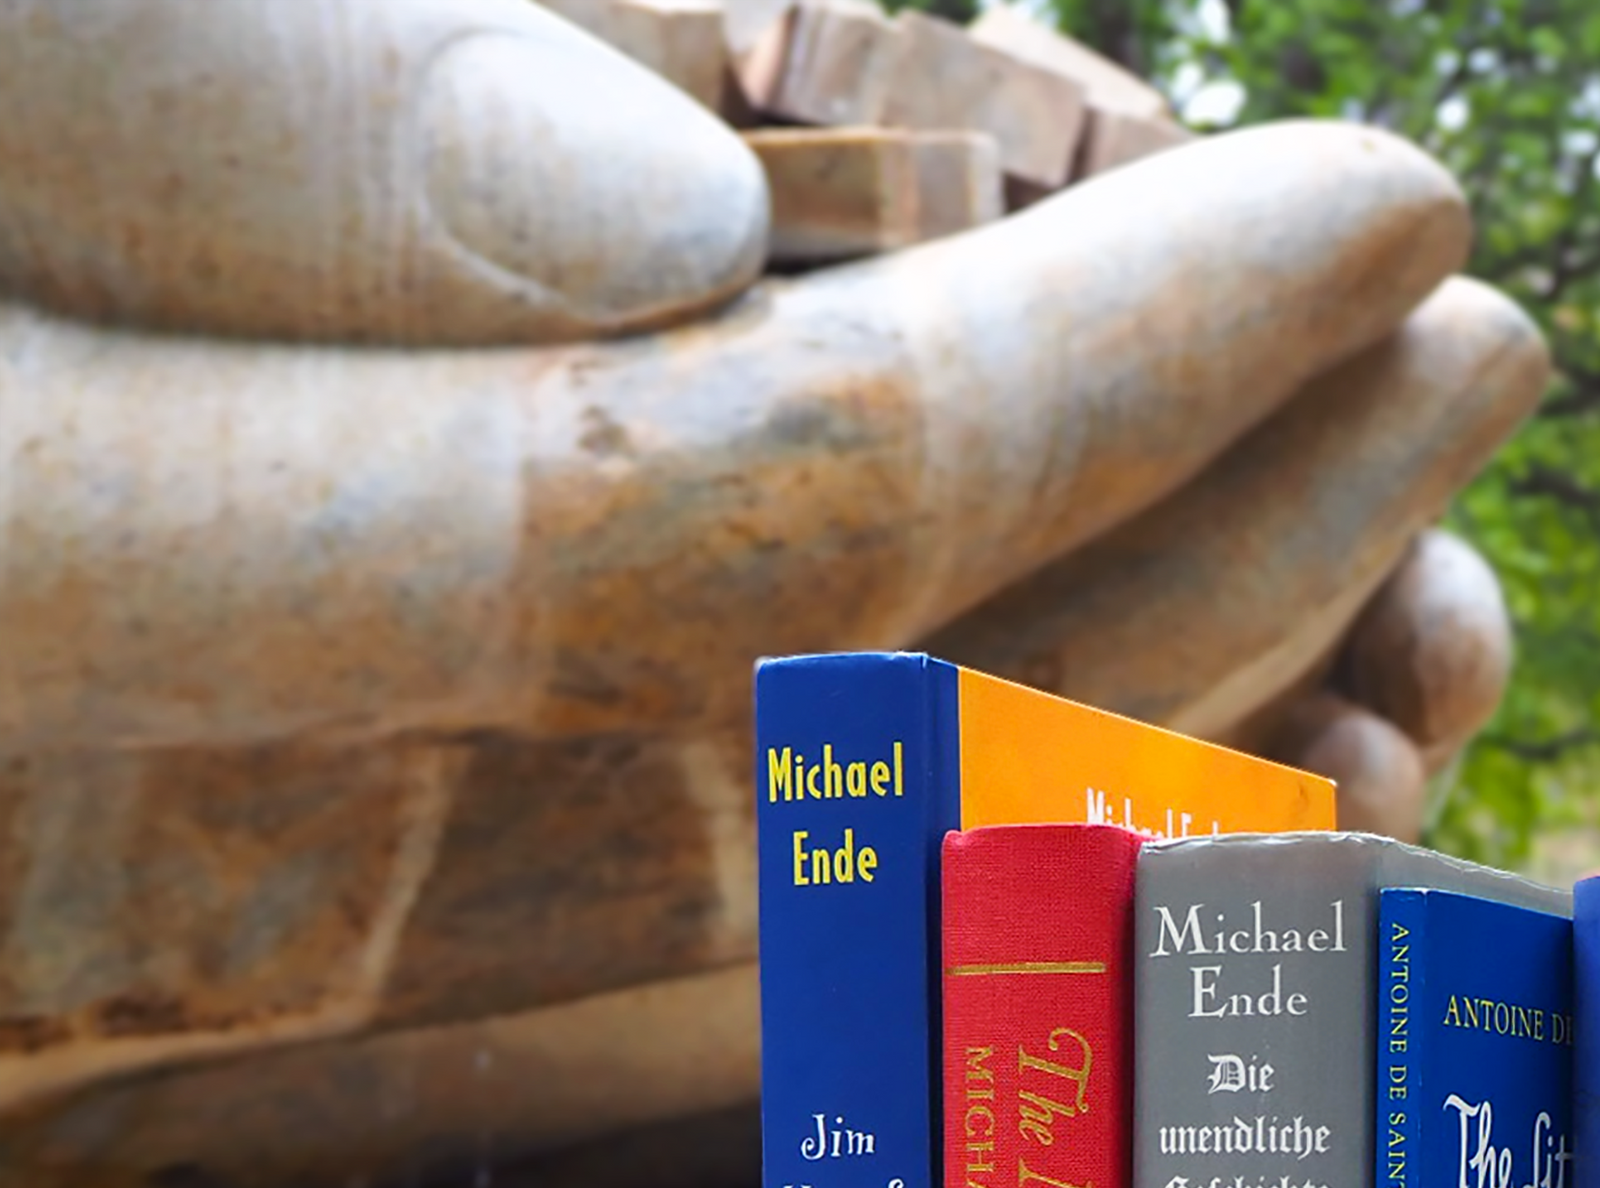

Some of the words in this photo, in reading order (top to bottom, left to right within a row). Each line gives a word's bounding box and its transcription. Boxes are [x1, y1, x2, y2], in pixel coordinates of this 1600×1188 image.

[767, 741, 903, 803] Michael
[793, 828, 878, 886] Ende
[1149, 900, 1346, 958] Michael
[1187, 963, 1308, 1018] Ende
[1389, 923, 1410, 1053] ANTOINE
[1443, 994, 1544, 1041] ANTOINE
[1017, 1027, 1093, 1146] The
[1207, 1054, 1275, 1095] Die
[1389, 1065, 1408, 1100] DE
[800, 1113, 874, 1160] Jim
[1159, 1115, 1331, 1160] unendliche
